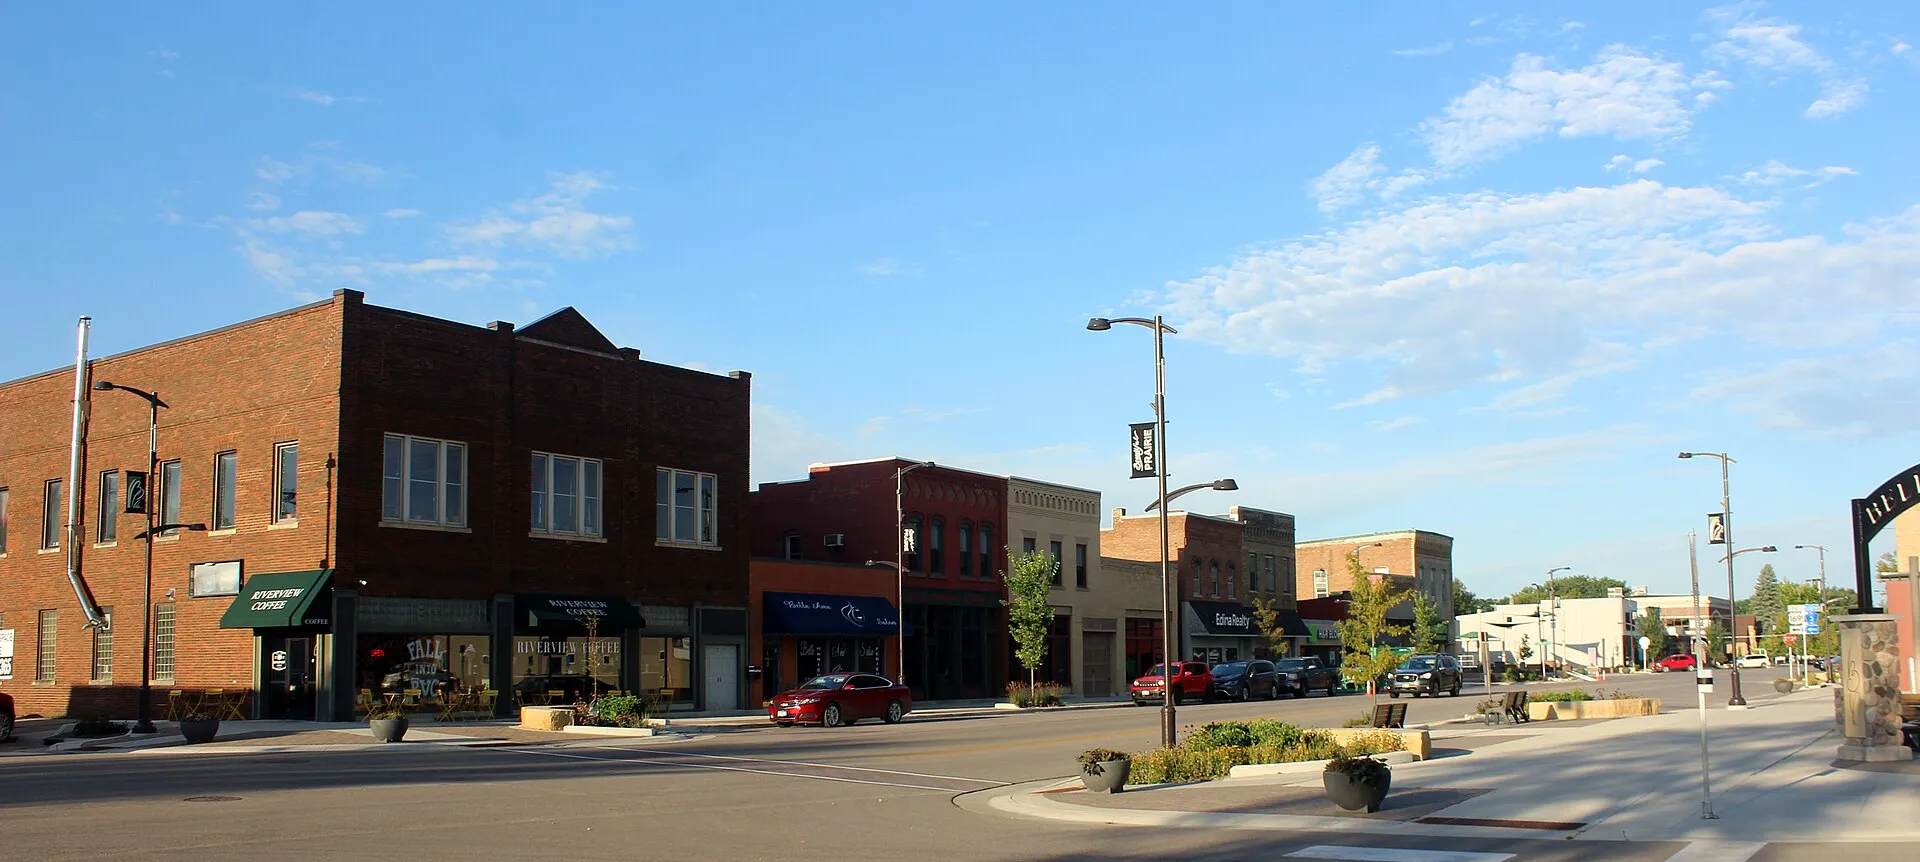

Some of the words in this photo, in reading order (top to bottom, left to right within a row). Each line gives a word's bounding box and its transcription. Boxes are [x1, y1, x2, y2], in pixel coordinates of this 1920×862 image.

[1143, 429, 1153, 471] PRAIRIE
[250, 588, 305, 600] RIVERVIEW
[251, 600, 288, 611] COFFEE
[549, 599, 607, 608] RIVERVIEW
[566, 608, 608, 616] COFFEE
[1215, 612, 1231, 626] Edina
[1231, 613, 1249, 629] Realty
[406, 639, 443, 661] FALL
[517, 640, 576, 654] RIVERVIEW
[415, 664, 437, 675] INTO
